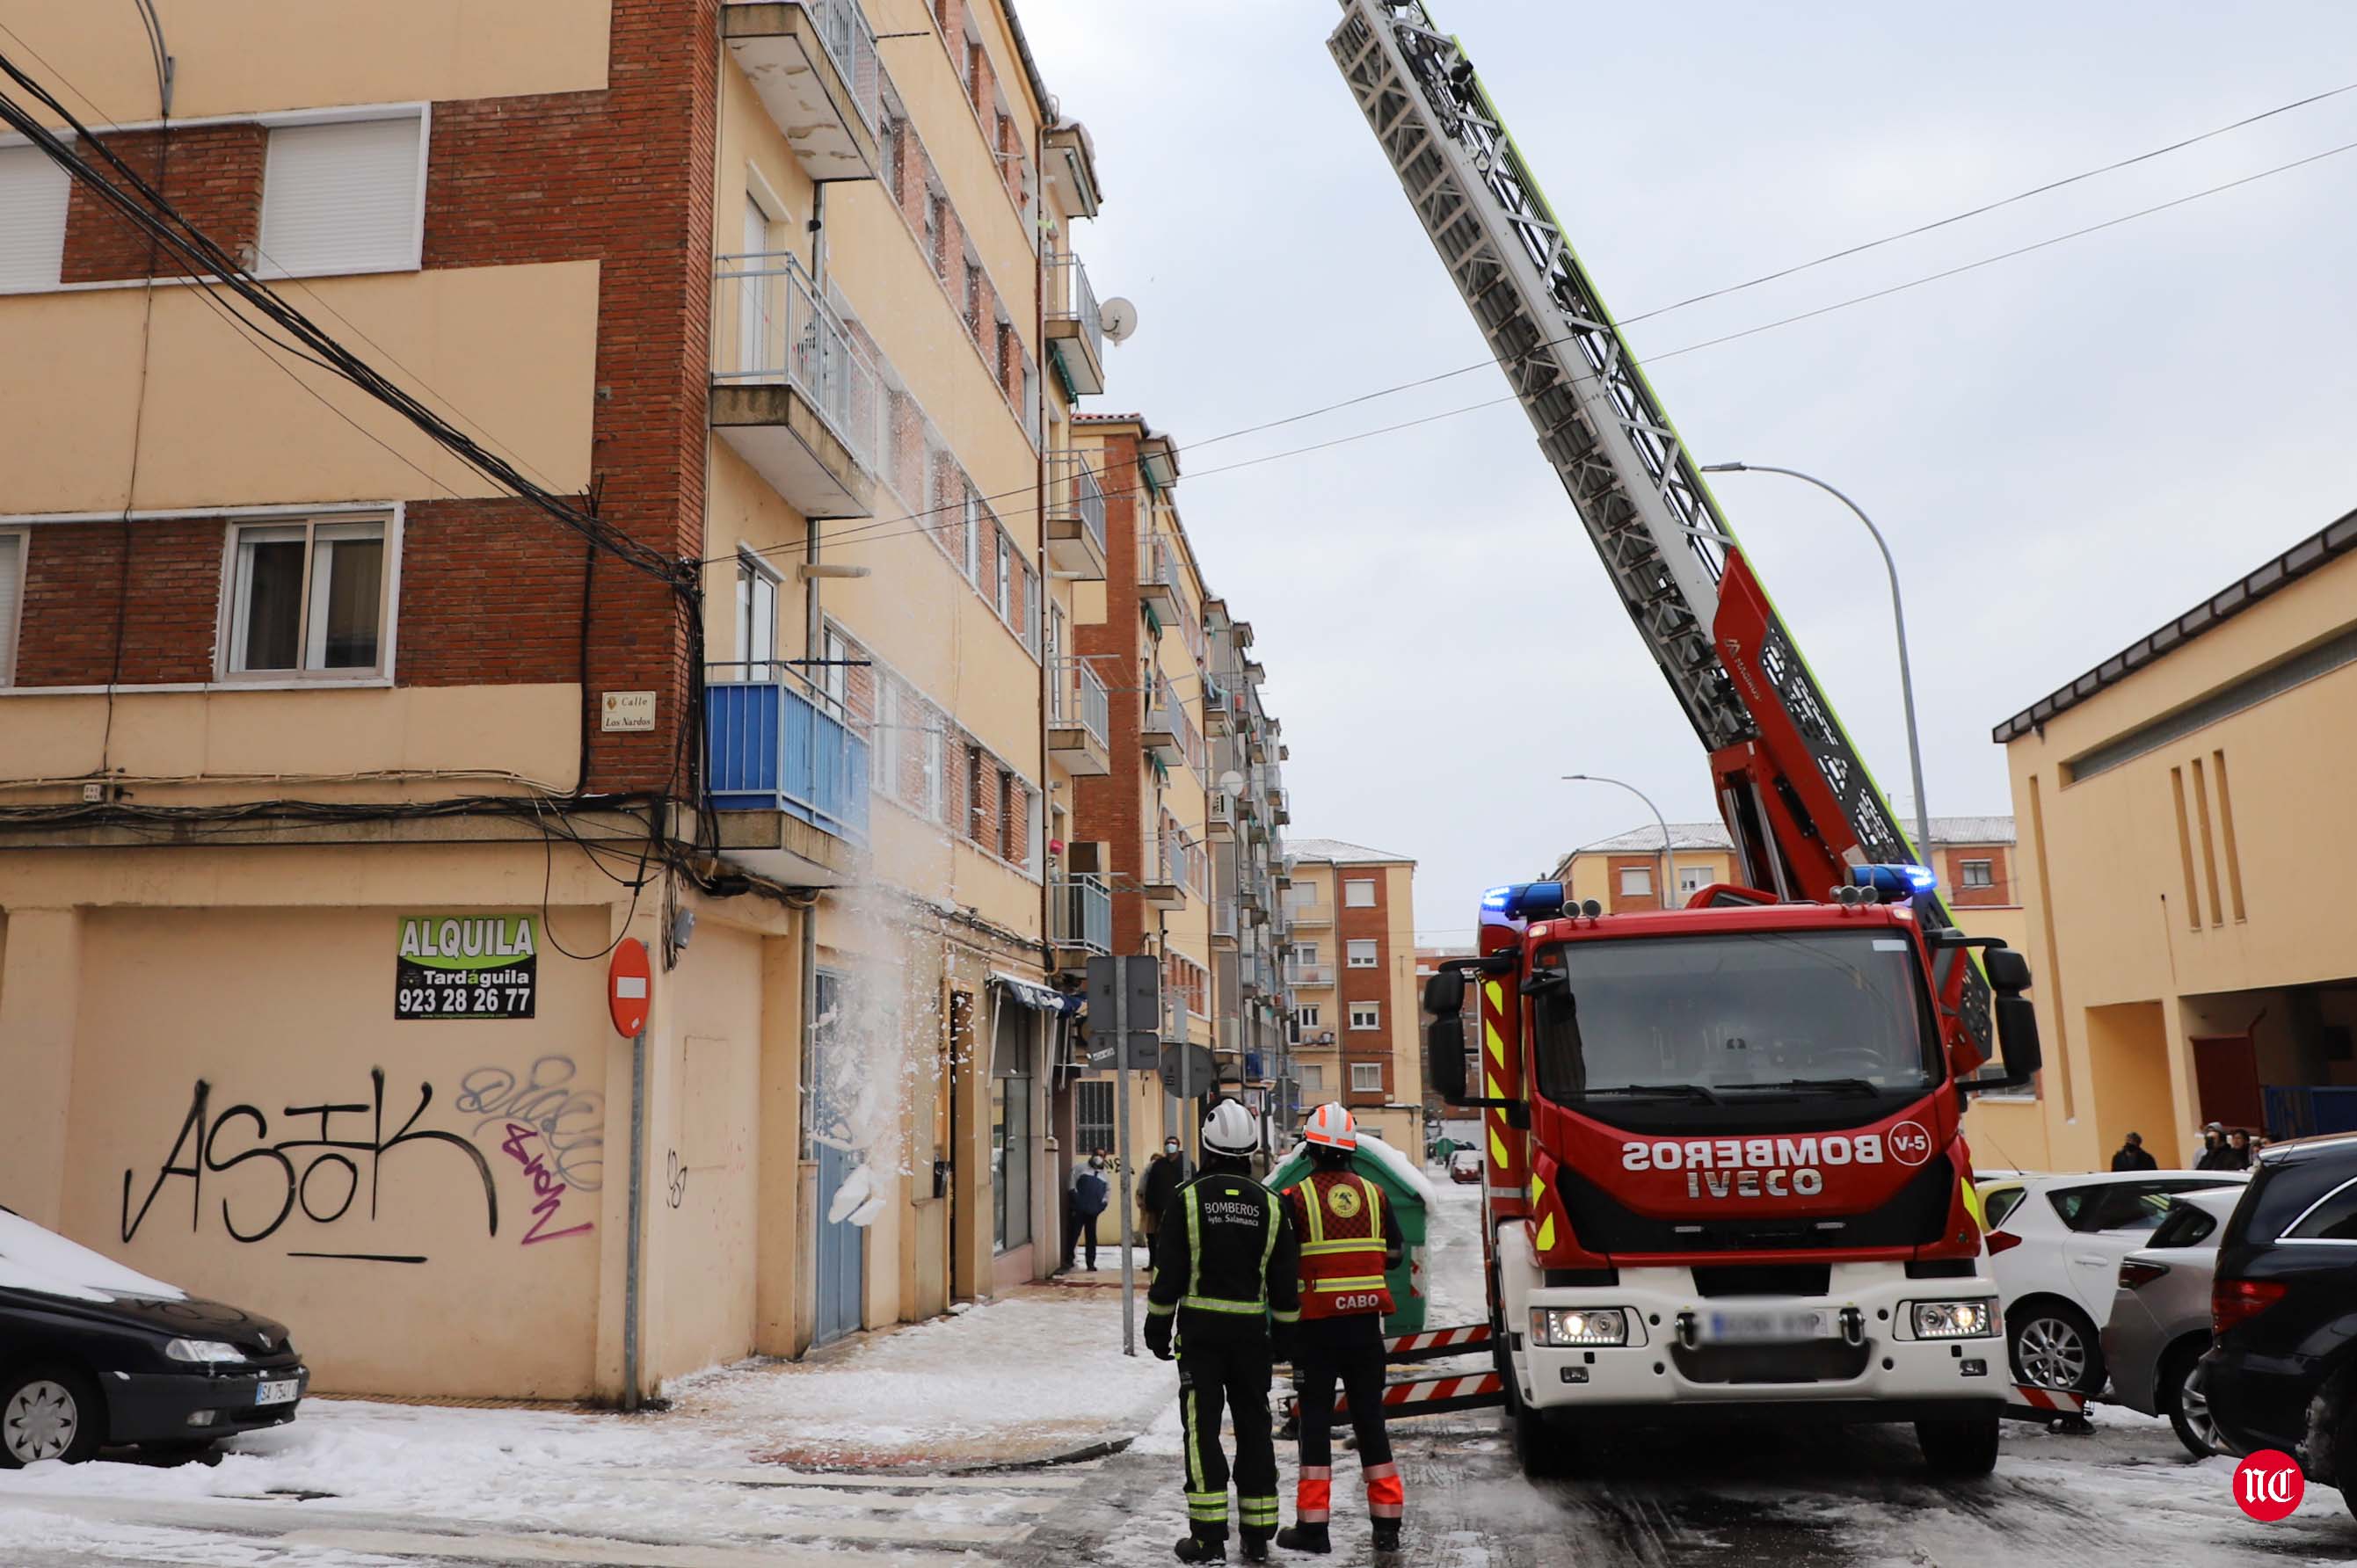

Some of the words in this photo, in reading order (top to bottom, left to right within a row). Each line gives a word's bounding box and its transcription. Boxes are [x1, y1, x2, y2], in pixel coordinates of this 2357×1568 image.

[622, 696, 647, 707] Calle
[606, 717, 620, 727] Los
[622, 716, 651, 726] Nardos
[399, 918, 535, 960] ALQUILA
[424, 969, 529, 987] Tardáguila
[399, 989, 436, 1012] 923
[442, 989, 467, 1012] 28
[474, 989, 498, 1012] 26
[506, 988, 530, 1011] 77
[1894, 1135, 1925, 1151] V-5
[1688, 1169, 1823, 1198] IVECO
[1204, 1202, 1259, 1216] BOMBEROS
[1225, 1214, 1259, 1226] Salamanca
[1335, 1294, 1379, 1310] CABO
